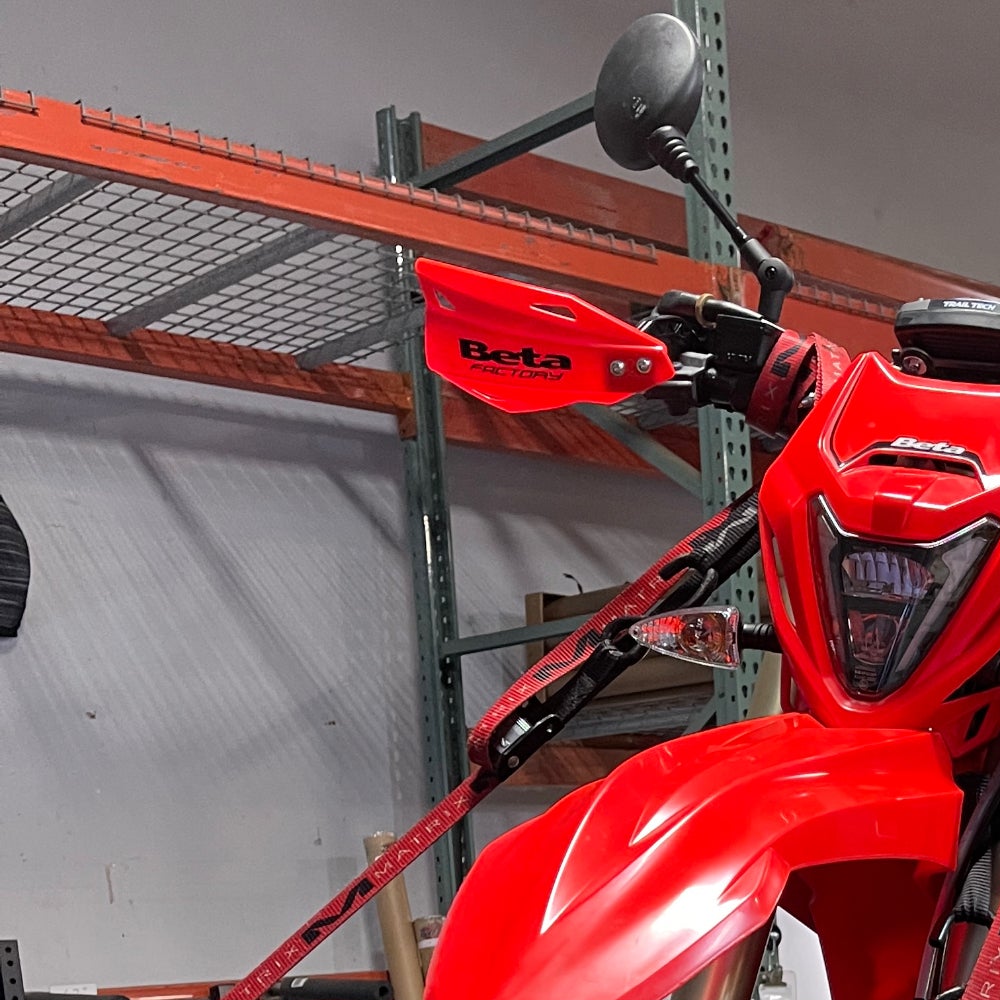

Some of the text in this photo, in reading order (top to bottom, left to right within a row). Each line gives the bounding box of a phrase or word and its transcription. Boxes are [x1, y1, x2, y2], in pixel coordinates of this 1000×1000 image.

[943, 300, 997, 311] TRAIL TECH
[459, 338, 571, 370] Beta
[470, 364, 564, 381] FACTORY
[890, 437, 965, 454] Beta
[374, 796, 468, 879] MATRIX
